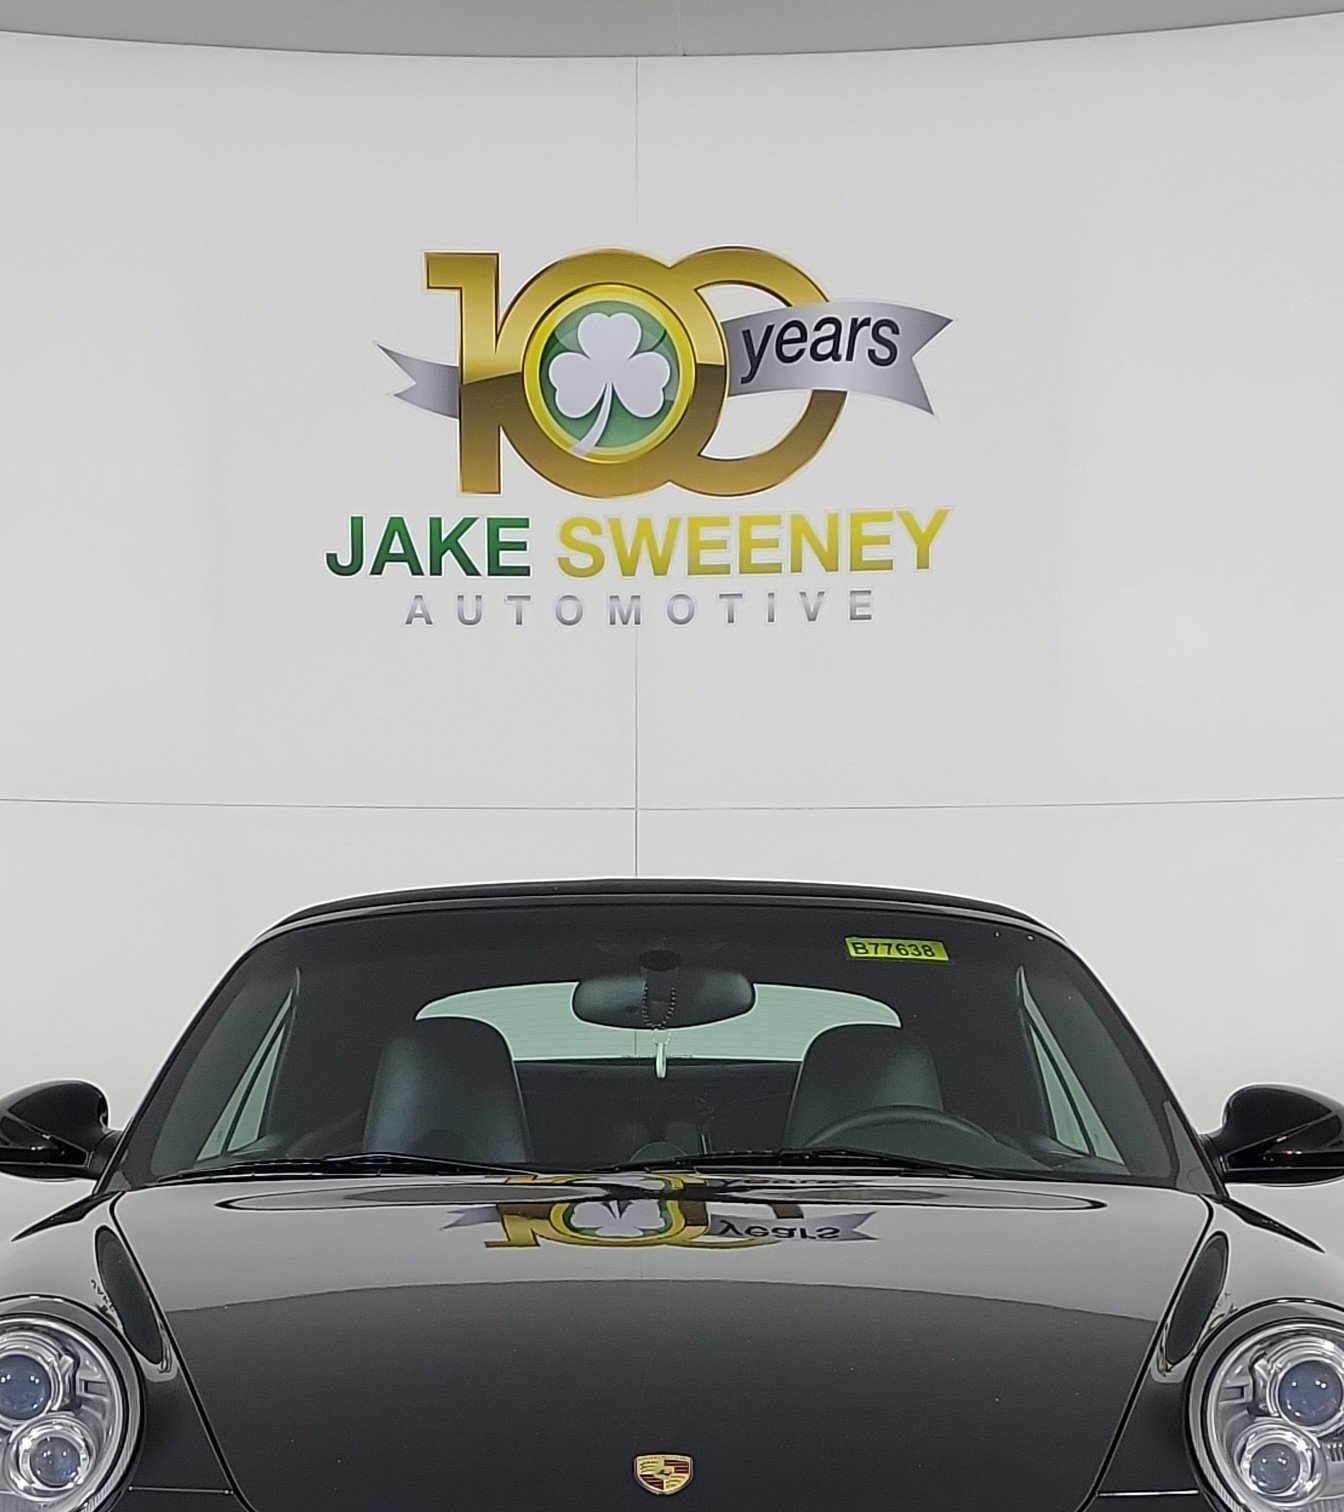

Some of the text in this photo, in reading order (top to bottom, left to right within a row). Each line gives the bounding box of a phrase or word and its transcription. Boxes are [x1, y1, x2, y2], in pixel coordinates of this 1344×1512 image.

[424, 245, 901, 498] 100 years
[325, 508, 950, 577] JAKE SWEENEY
[404, 590, 873, 626] AUTOMOTIVE
[851, 942, 936, 958] B77638
